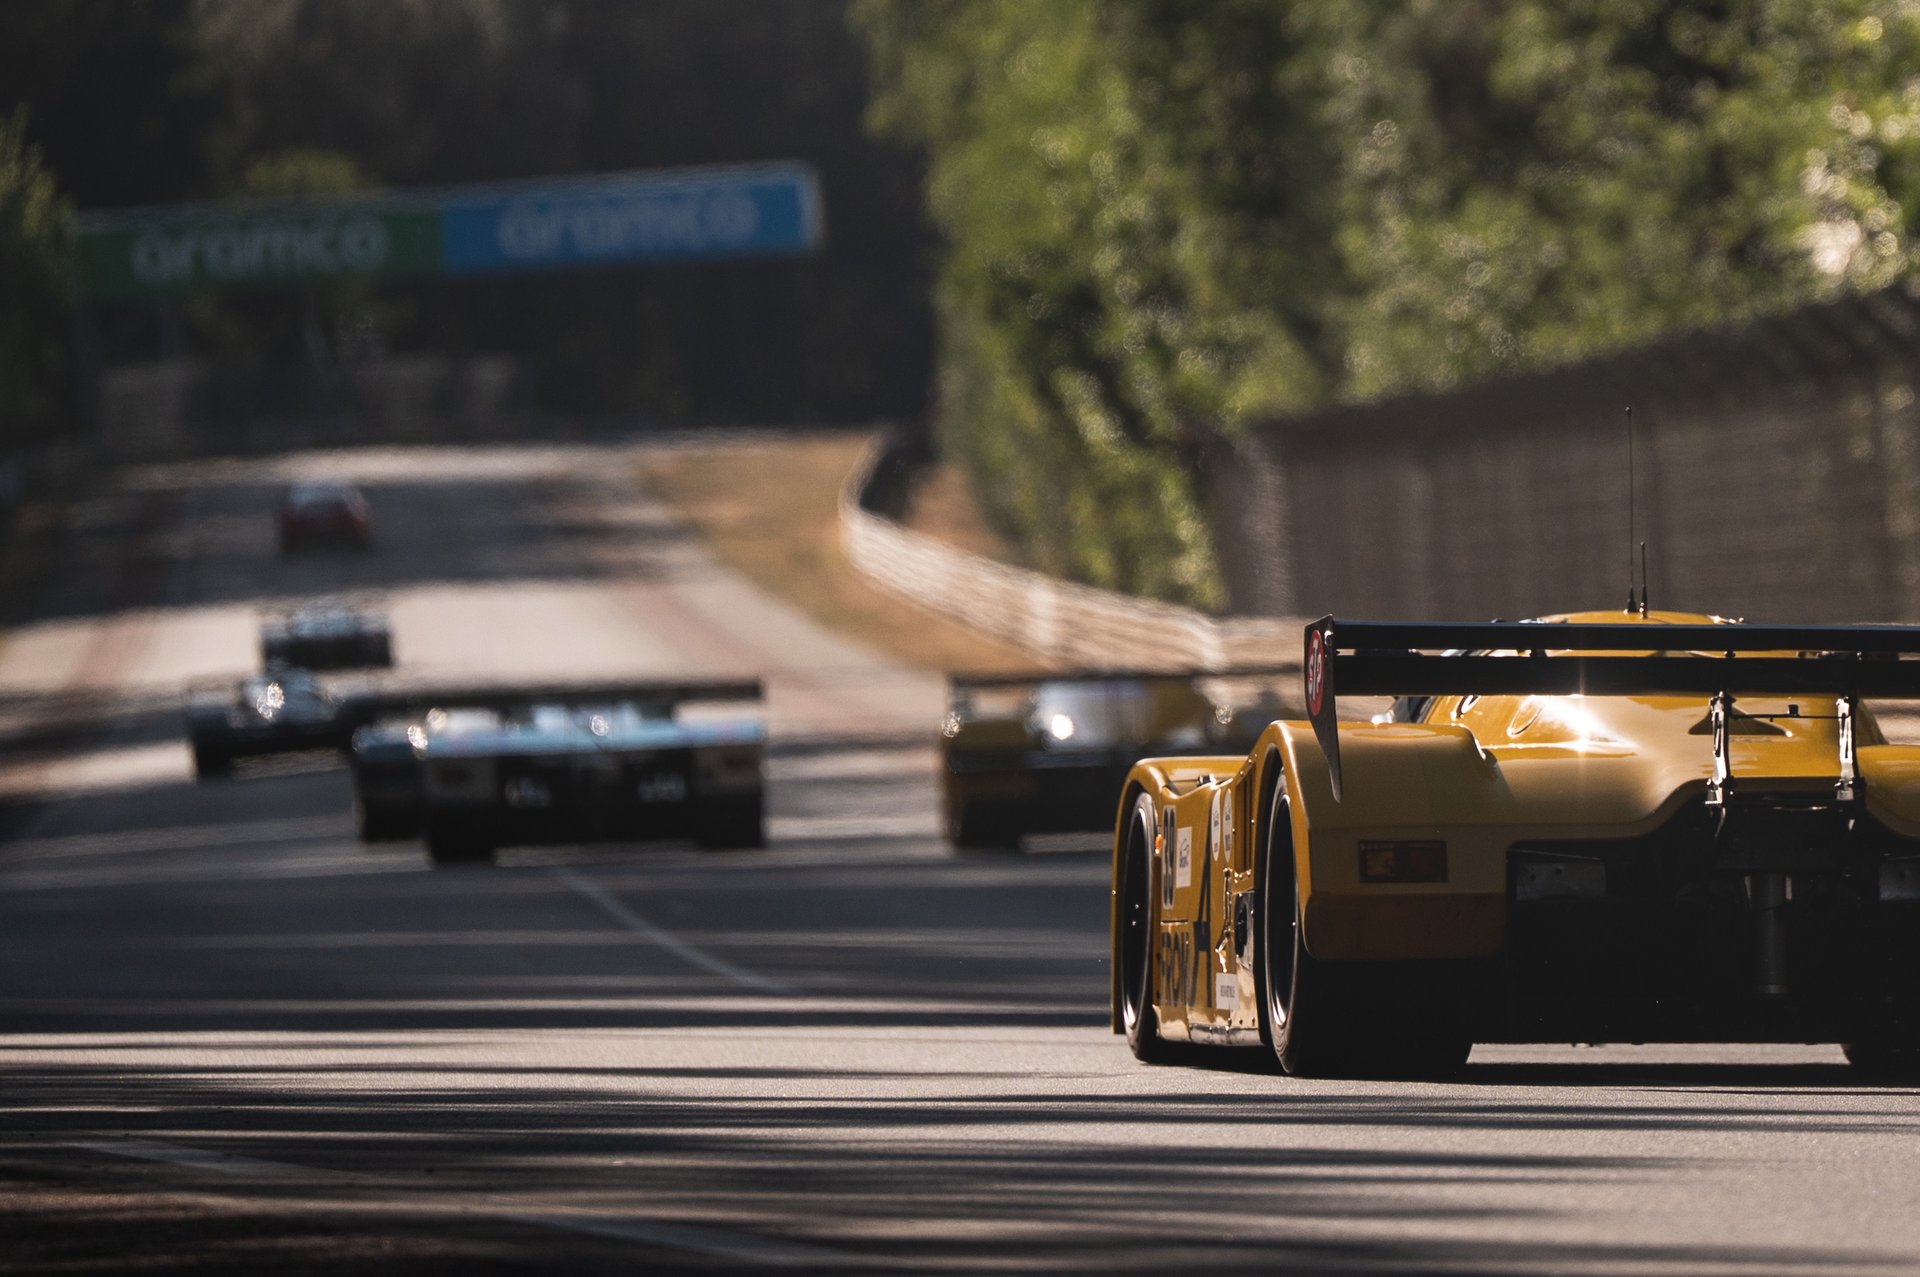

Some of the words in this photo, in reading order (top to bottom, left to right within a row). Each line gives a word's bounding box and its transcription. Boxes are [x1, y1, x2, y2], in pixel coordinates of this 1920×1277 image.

[132, 213, 388, 284] aramco
[496, 193, 759, 260] aramco
[1308, 639, 1322, 700] STP
